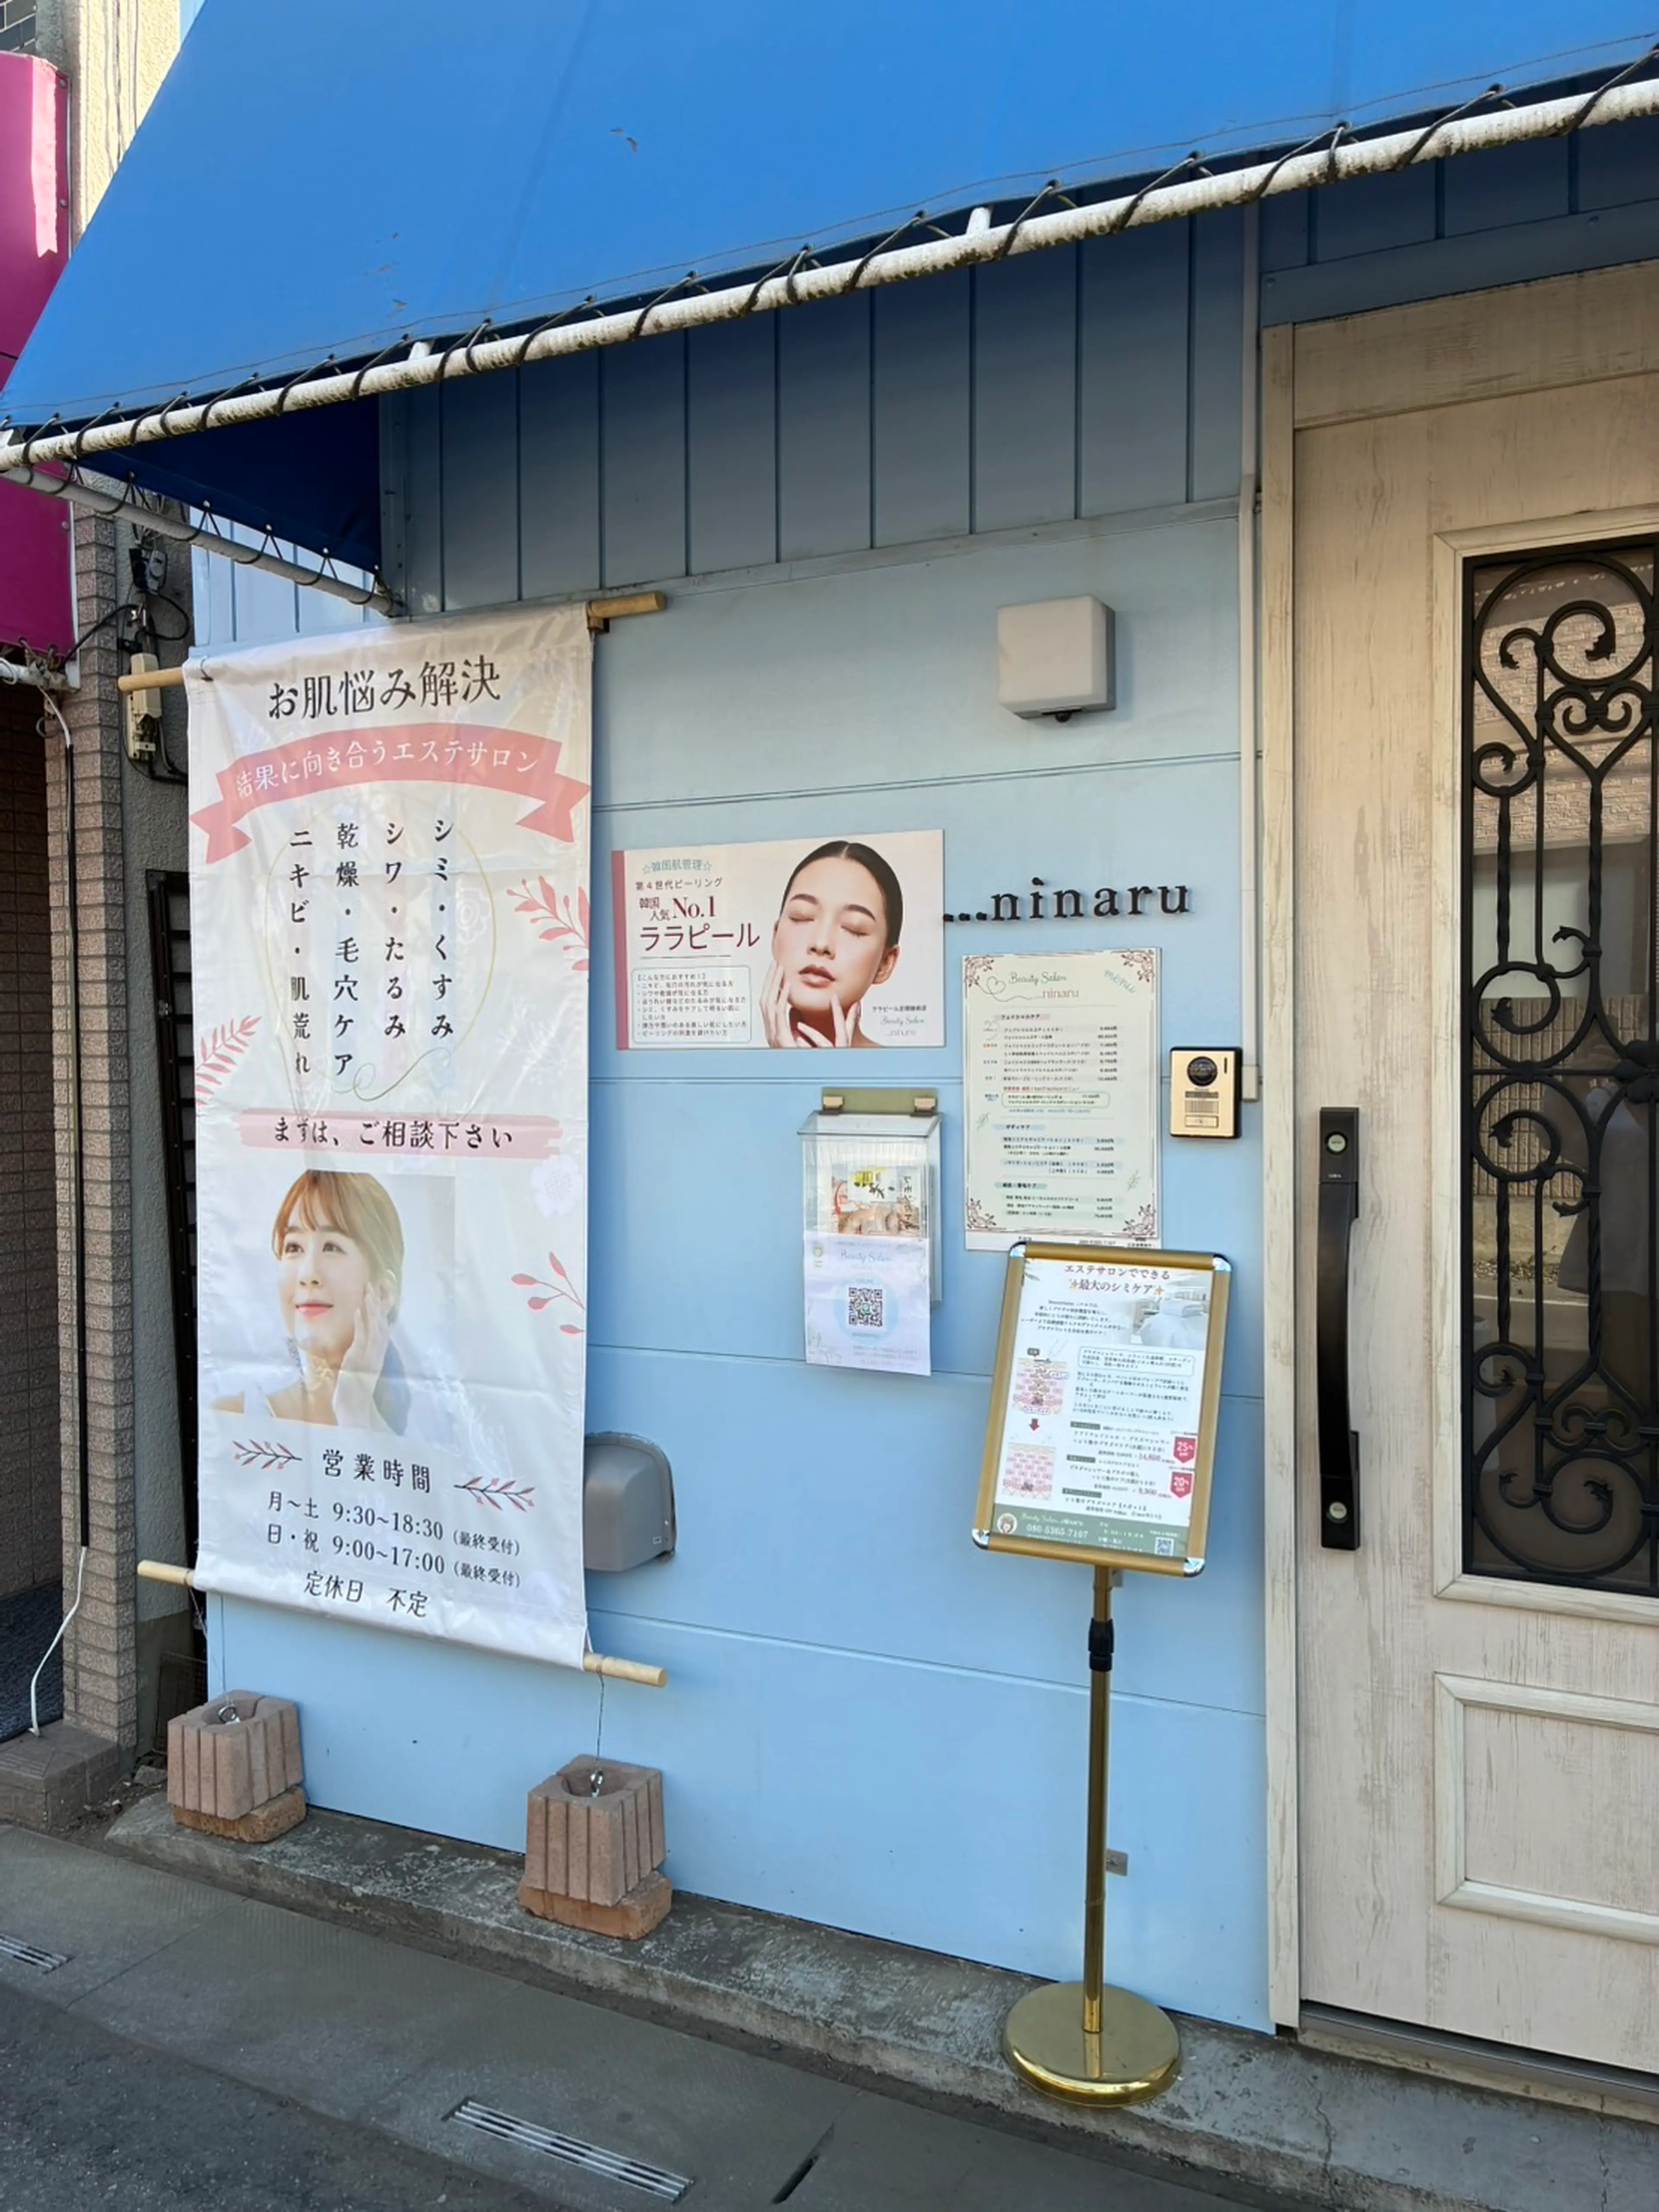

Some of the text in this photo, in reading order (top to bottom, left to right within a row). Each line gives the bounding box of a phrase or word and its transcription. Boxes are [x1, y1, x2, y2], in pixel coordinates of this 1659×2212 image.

[269, 654, 500, 719] お肌悩み解決
[236, 739, 538, 799] 結果に向き合うエステサロン
[639, 897, 659, 909] 韓国
[650, 895, 717, 921] 人気 No.1
[334, 822, 359, 1075] 乾燥・毛穴ケア
[384, 822, 407, 1038] シワ・たるみ
[431, 820, 454, 1037] シミ・くすみ
[640, 923, 760, 951] ララピール
[289, 830, 313, 1074] ニキビ・肌荒れ
[1009, 972, 1038, 986] Beauty
[275, 1117, 513, 1149] まずは、ご相談下さい
[1065, 1265, 1170, 1279] エステサロンでできる
[322, 1449, 431, 1493] 営業時間
[268, 1524, 319, 1553] 日・祝
[303, 1571, 429, 1618] 定休日 不定
